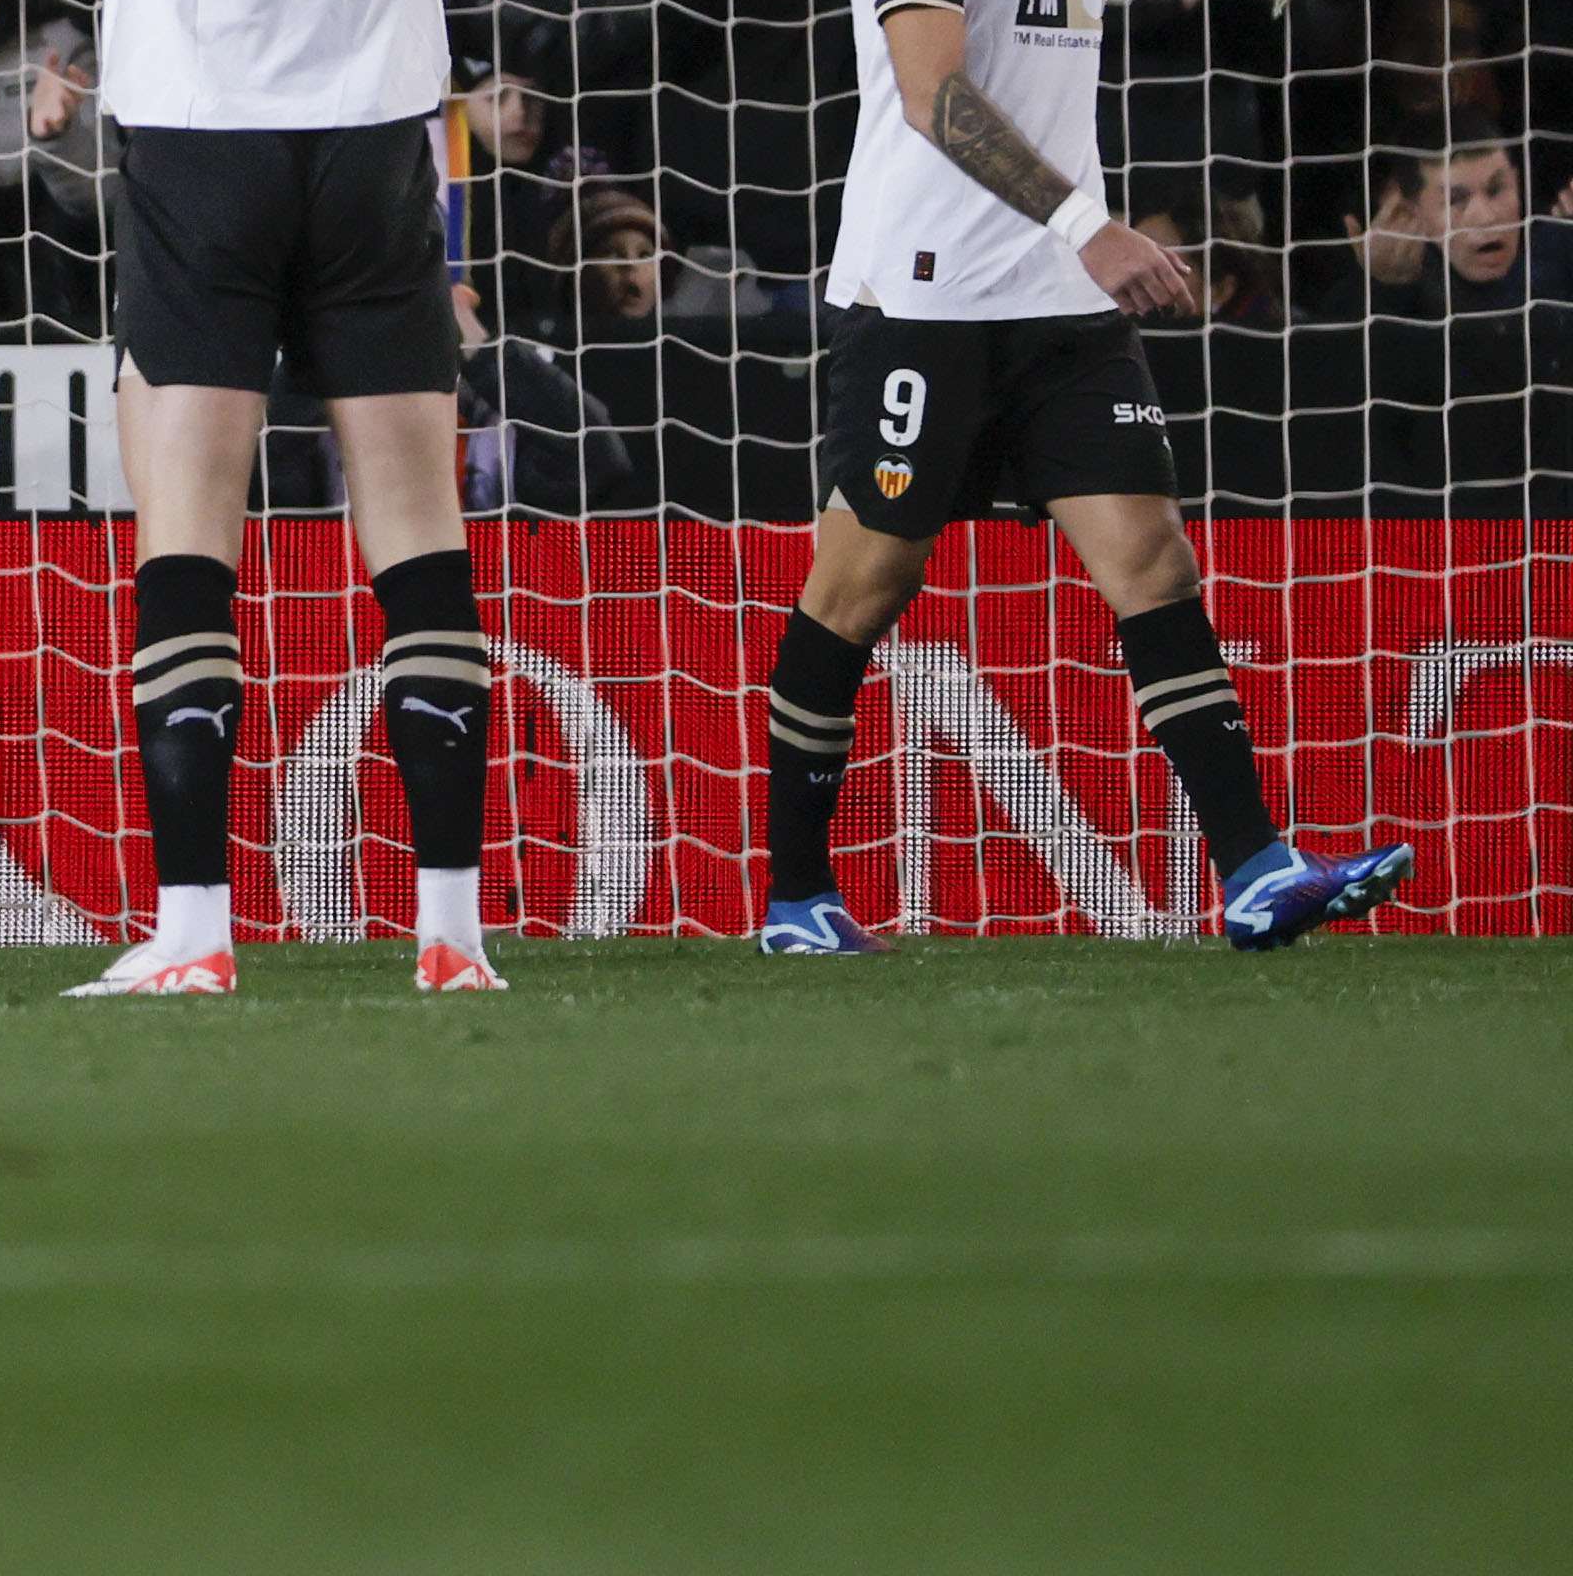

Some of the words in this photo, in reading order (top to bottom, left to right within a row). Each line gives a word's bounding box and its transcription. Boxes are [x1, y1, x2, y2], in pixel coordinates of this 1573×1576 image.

[1034, 33, 1055, 47] Real
[1058, 34, 1090, 49] Estate
[879, 369, 927, 447] 9
